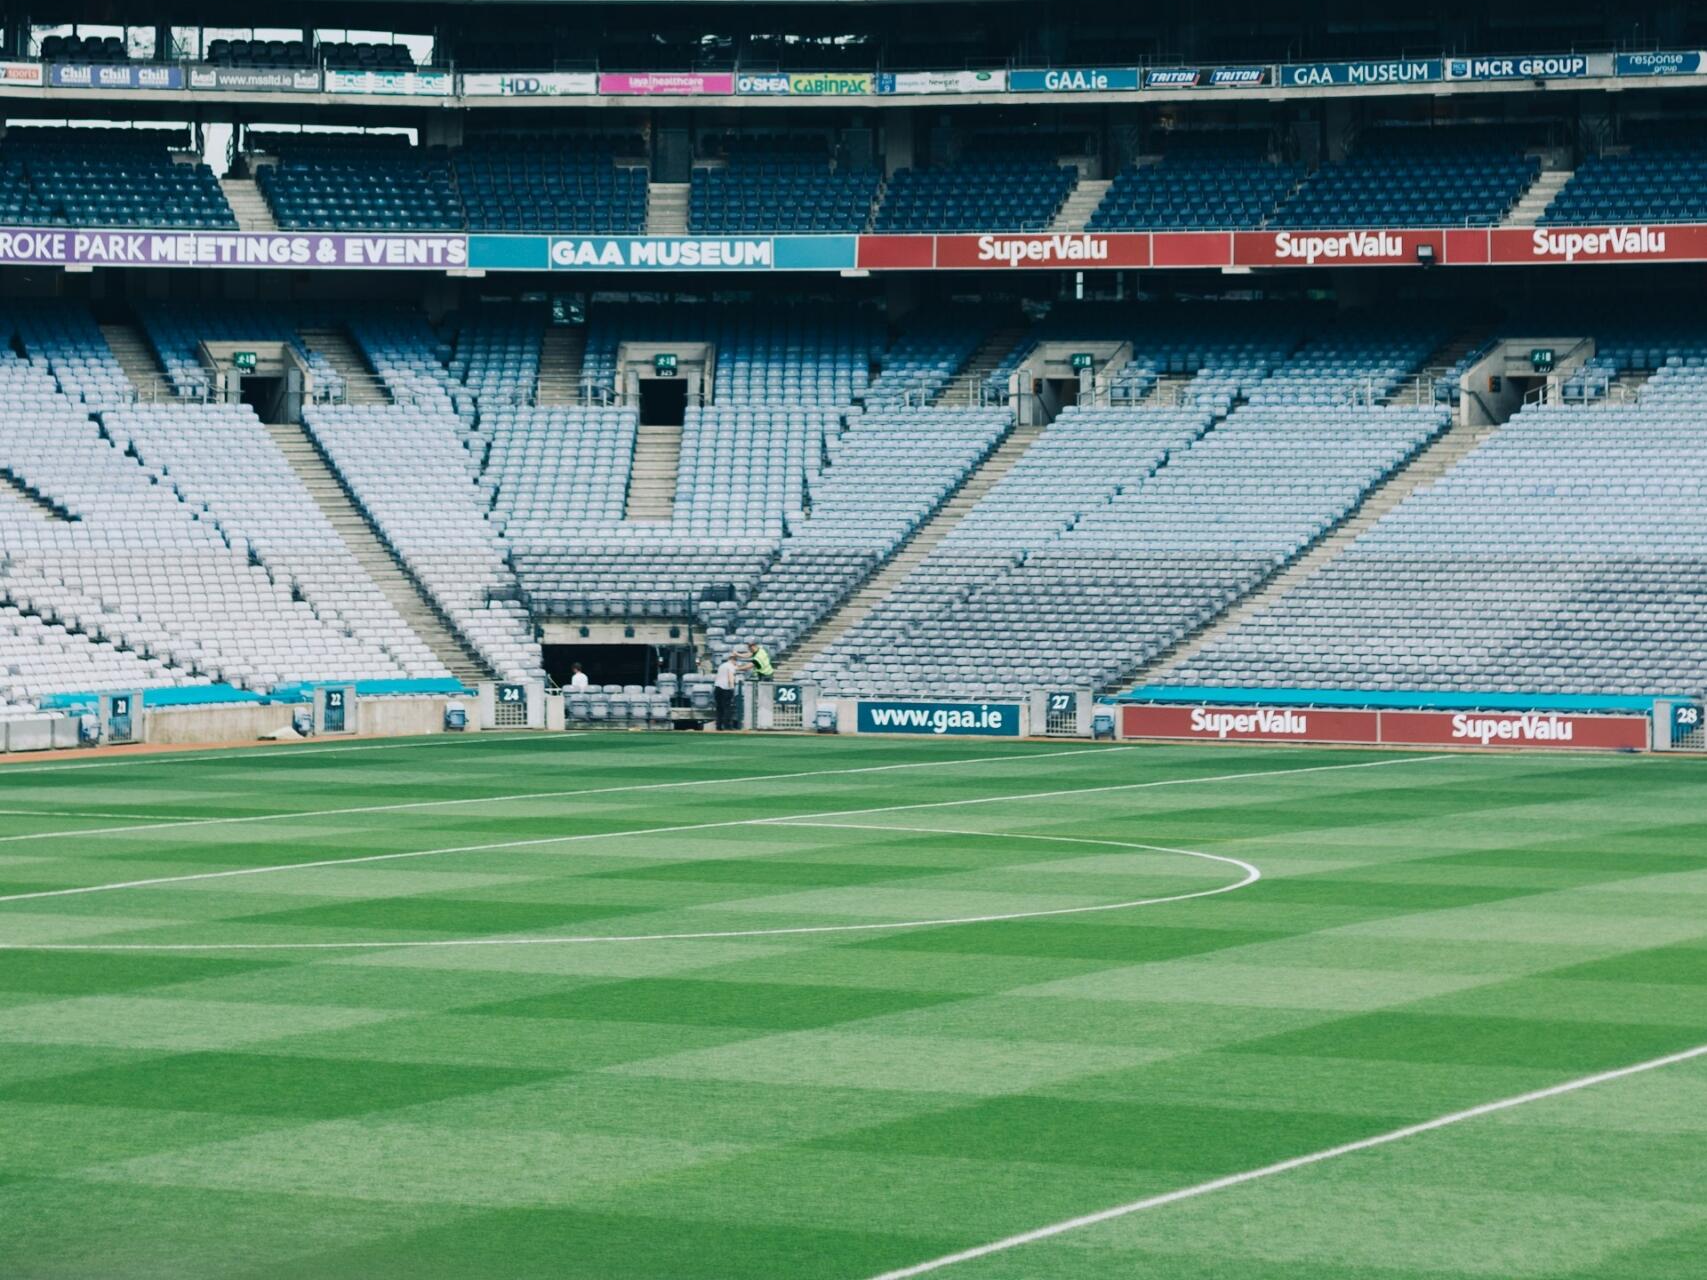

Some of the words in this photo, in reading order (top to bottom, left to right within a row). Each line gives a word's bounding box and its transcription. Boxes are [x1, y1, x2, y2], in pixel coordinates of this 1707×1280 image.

[1475, 61, 1513, 75] MCR
[1519, 59, 1584, 74] GROUP
[1630, 55, 1683, 66] response
[1654, 65, 1677, 73] group
[652, 76, 703, 86] healthcare
[1045, 70, 1108, 89] GAA.ie
[1151, 72, 1196, 82] TRITON
[1215, 71, 1260, 81] TRITON
[1294, 67, 1333, 84] GAA
[1349, 63, 1428, 81] MUSEUM
[74, 234, 145, 260] PARK
[150, 235, 311, 263] MEETINGS
[315, 237, 337, 263] &
[344, 238, 466, 263] EVENTS
[978, 234, 1107, 267] SuperValu
[1275, 231, 1402, 264] SuperValu
[1533, 227, 1666, 261] SuperValu
[552, 240, 625, 265] GAA
[630, 241, 771, 266] MUSEUM
[331, 693, 341, 706] 22
[503, 688, 519, 700] 24
[778, 687, 797, 701] 26
[1052, 695, 1070, 709] 27
[871, 705, 1002, 733] www.gaa.ie
[1191, 708, 1306, 738] SuperValu
[1677, 707, 1698, 724] 28
[1452, 714, 1572, 744] SuperValu
